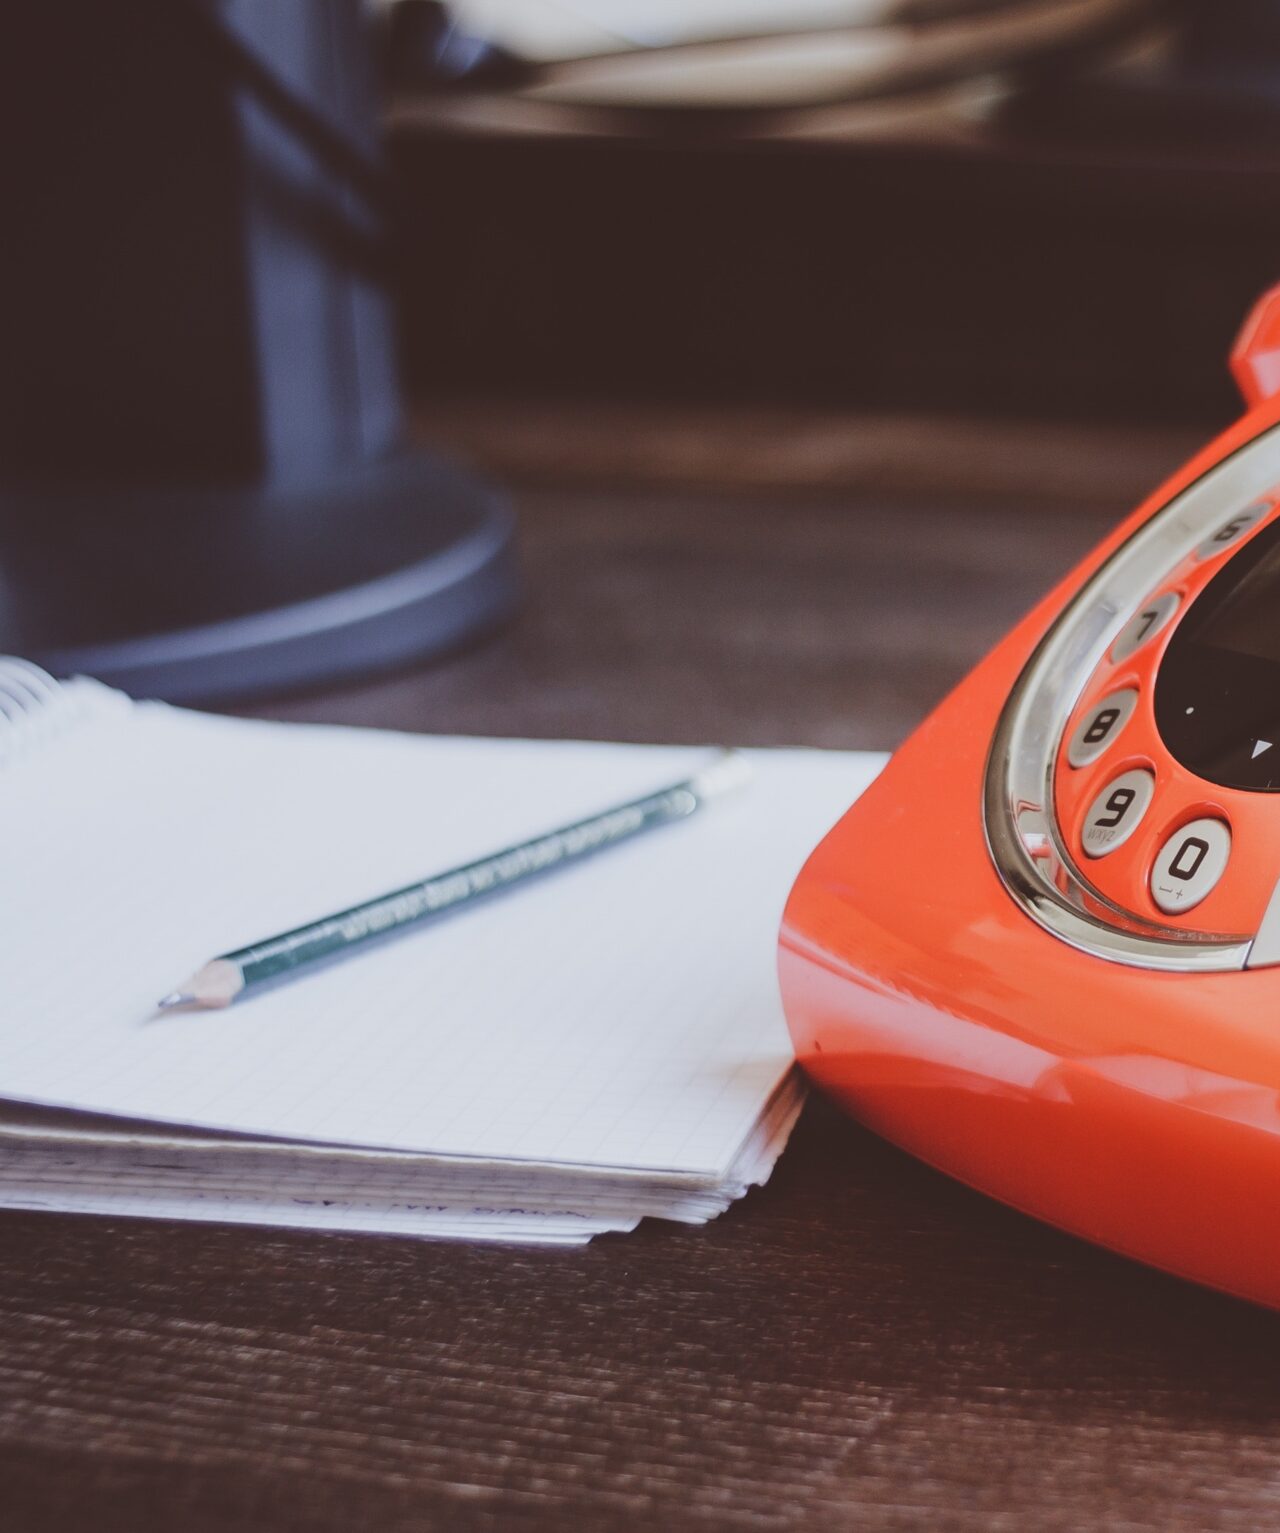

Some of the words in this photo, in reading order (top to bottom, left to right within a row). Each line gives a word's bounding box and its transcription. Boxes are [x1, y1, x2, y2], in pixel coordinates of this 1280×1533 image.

[1213, 515, 1252, 542] 6
[1137, 611, 1159, 641] 7
[1083, 708, 1121, 744] 8
[1094, 788, 1136, 828] 9
[1168, 837, 1210, 881] 0
